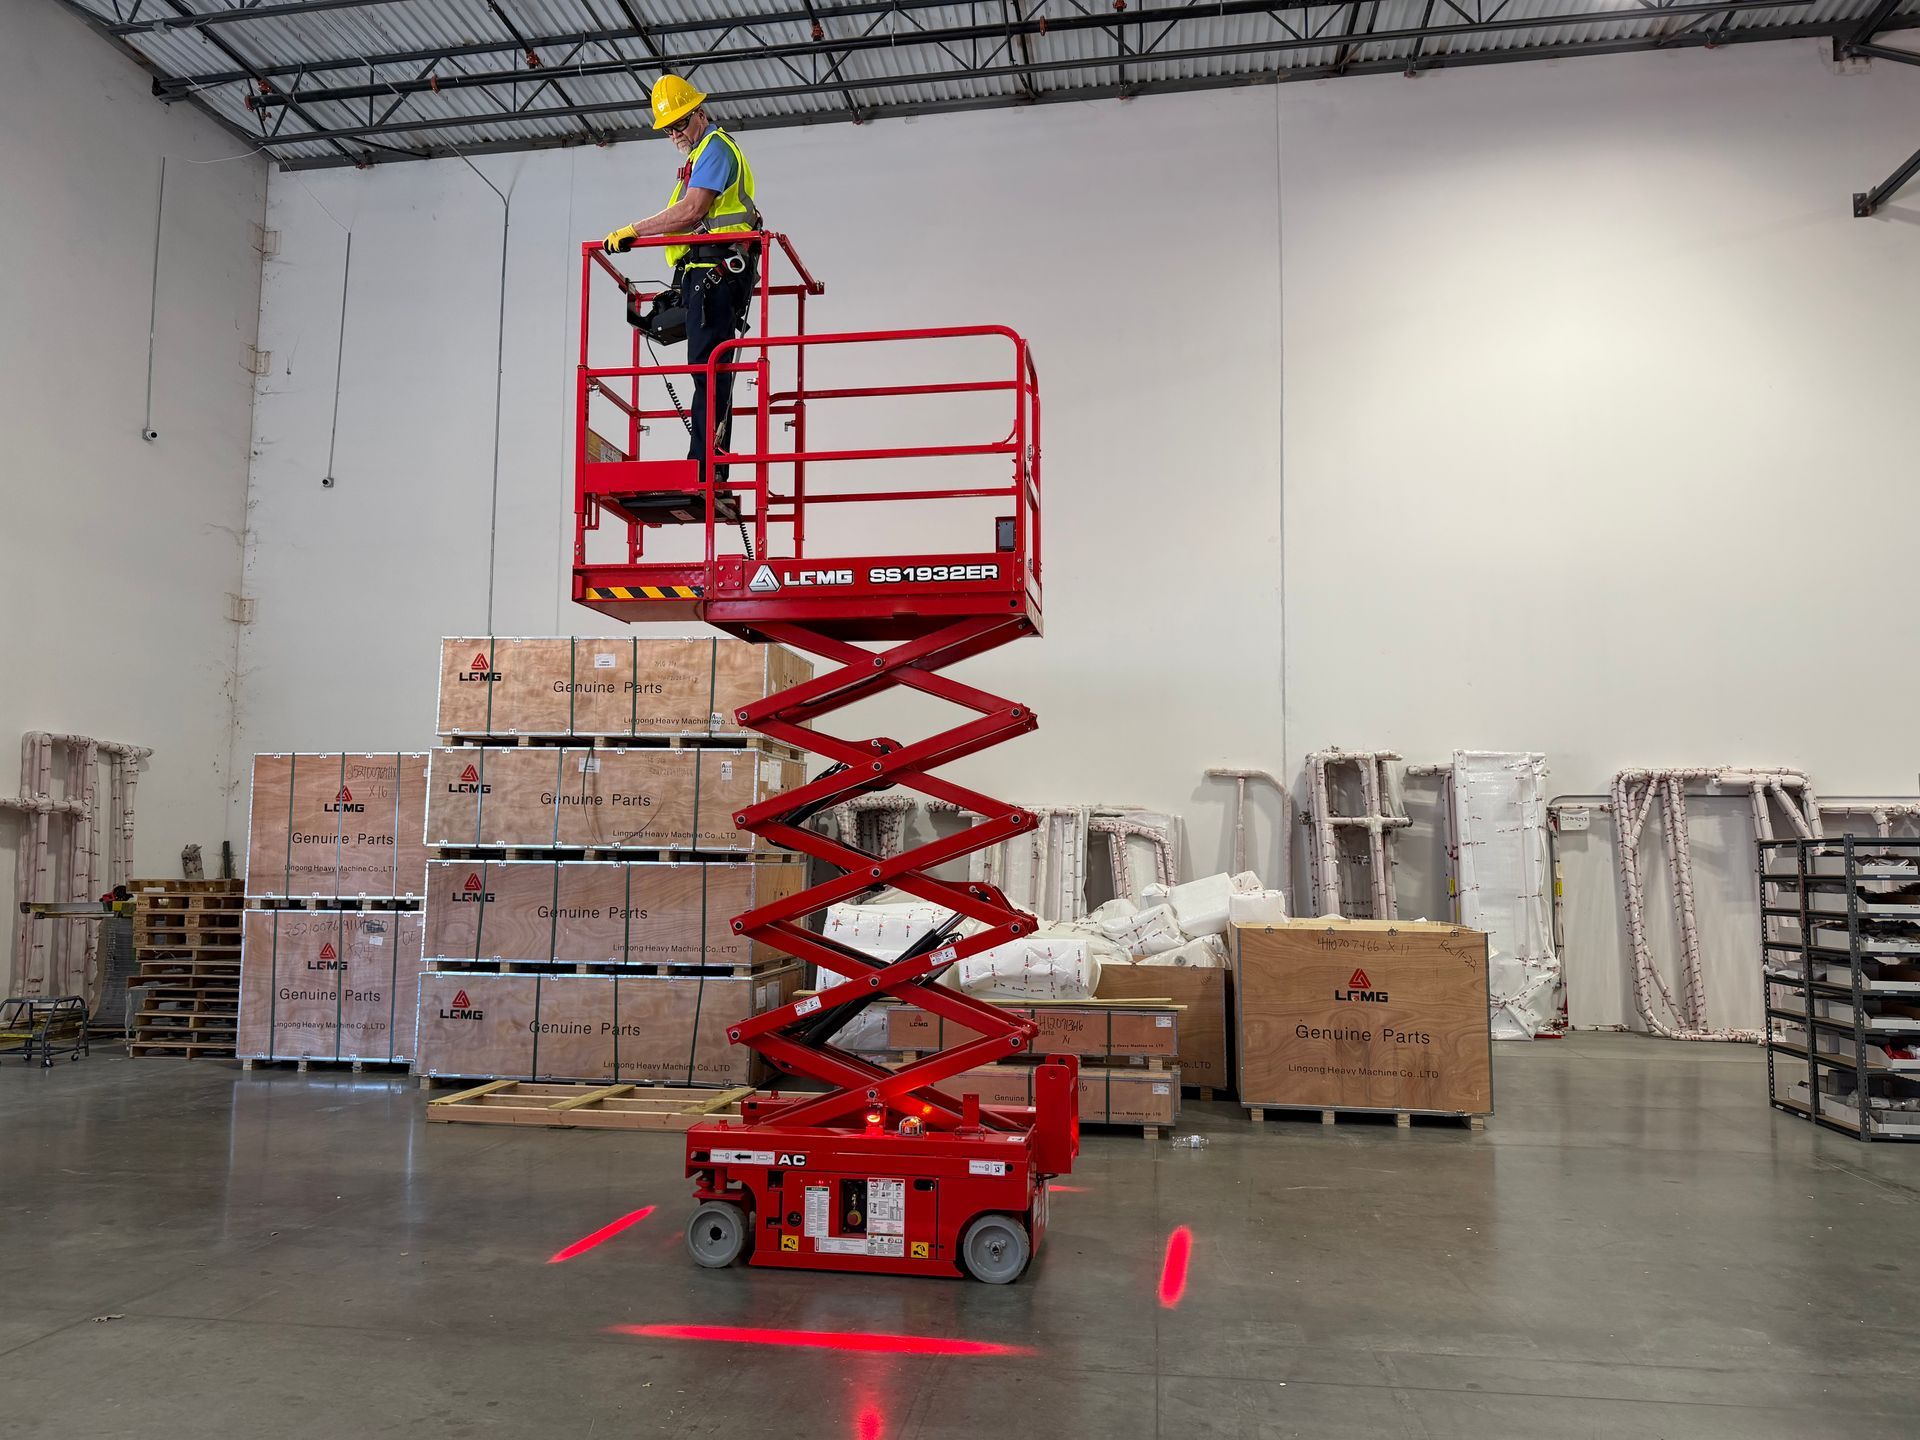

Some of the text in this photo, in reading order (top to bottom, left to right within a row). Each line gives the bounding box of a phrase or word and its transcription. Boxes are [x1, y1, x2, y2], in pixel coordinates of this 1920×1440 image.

[784, 569, 853, 586] LGMG
[869, 564, 998, 583] SS1932ER
[459, 672, 502, 682] LGMG
[553, 681, 662, 694] Genuine Parts
[656, 717, 680, 726] Heavy
[448, 783, 491, 794] LGMG
[540, 792, 650, 807] Genuine Parts
[357, 833, 394, 845] Parts
[645, 830, 669, 839] Heavy
[452, 892, 495, 903] LGMG
[537, 906, 648, 919] Genuine Parts
[279, 988, 381, 1002] Genuine Parts
[1334, 989, 1388, 1003] LGMG
[439, 1009, 483, 1020] LGMG
[529, 1021, 640, 1037] Genuine Parts
[1295, 1025, 1430, 1045] Genuine Parts
[637, 1062, 661, 1071] Heavy
[1288, 1063, 1326, 1076] Lingong
[1327, 1065, 1357, 1077] Heavy
[1358, 1067, 1398, 1078] Machine
[778, 1154, 806, 1166] AC
